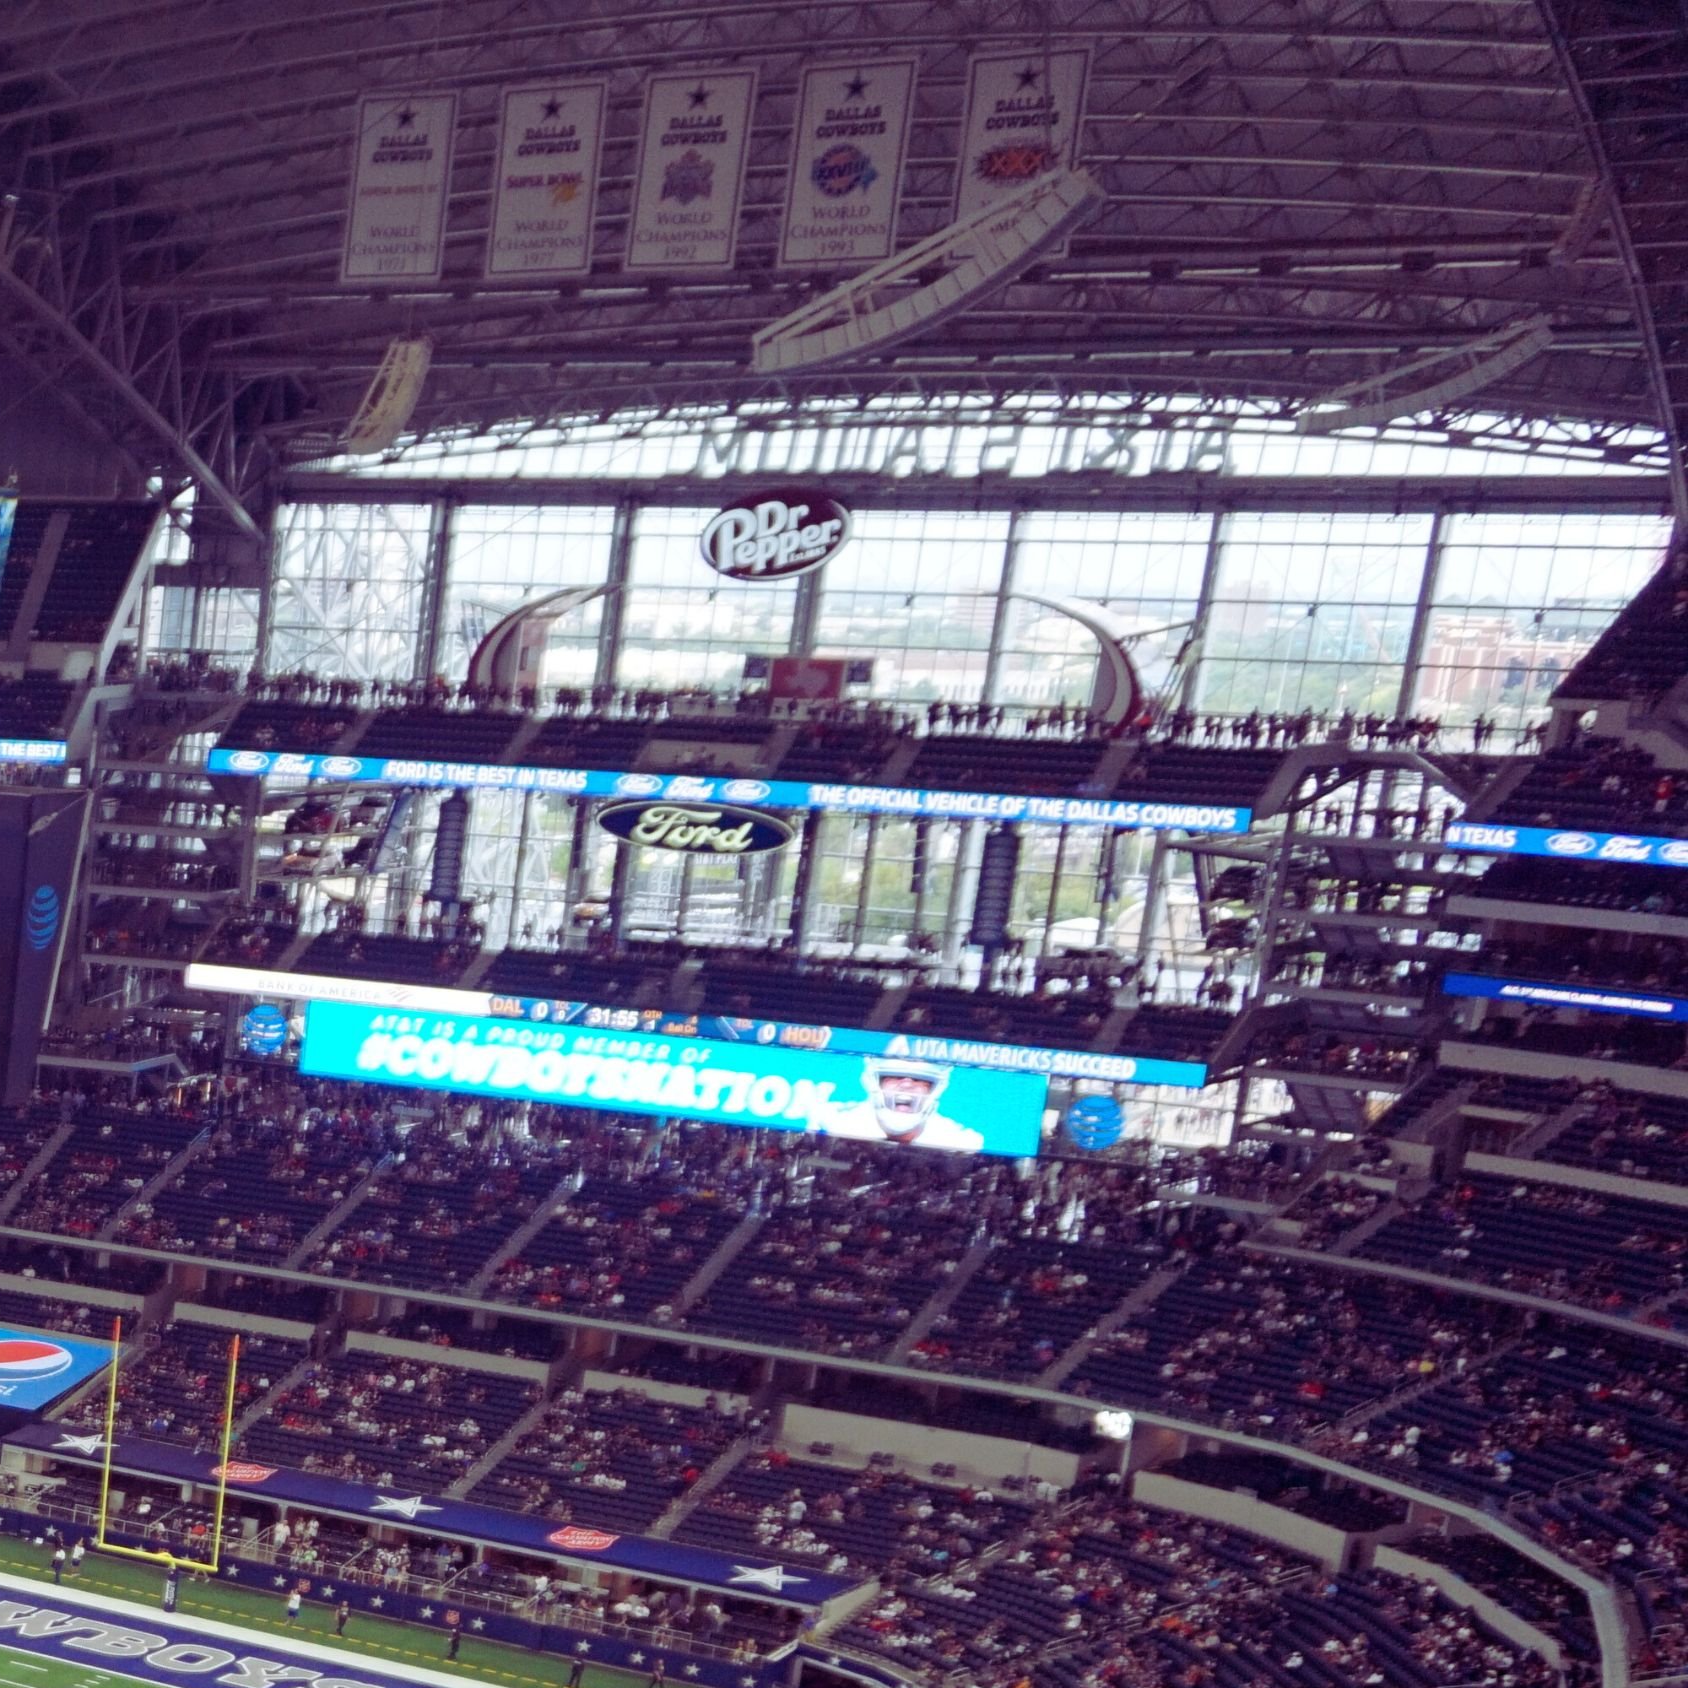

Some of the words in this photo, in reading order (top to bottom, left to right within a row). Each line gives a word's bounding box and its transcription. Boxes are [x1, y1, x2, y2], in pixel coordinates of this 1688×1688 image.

[669, 115, 723, 130] DALLAS
[825, 105, 882, 121] DALLAS
[525, 125, 577, 140] DALLAS
[661, 130, 728, 146] COWBOYS
[816, 121, 887, 139] COWBOYS
[379, 134, 429, 149] DALLAS
[517, 140, 582, 157] COWBOYS
[372, 148, 433, 163] COWBOYS
[657, 212, 712, 225] WORLD
[813, 205, 871, 219] WORLD
[515, 219, 569, 233] WORLD
[791, 224, 886, 239] CHAMPIONS
[755, 500, 809, 540] Dr
[0, 742, 25, 756] THE
[26, 742, 59, 757] BEST
[270, 752, 314, 773] Ford
[386, 760, 425, 778] FORD
[426, 762, 444, 779] IS
[446, 764, 471, 782] THE
[470, 766, 518, 783] BEST
[518, 768, 535, 785] IN
[535, 770, 588, 789] TEXAS
[664, 775, 715, 798] Ford
[809, 785, 846, 803] THE
[846, 788, 924, 809] OFFICIAL
[924, 791, 999, 812] VEHICLE
[999, 795, 1025, 814] OF
[1027, 797, 1064, 817] THE
[1065, 801, 1138, 821] DALLAS
[1143, 805, 1237, 828] COWBOYS
[629, 806, 754, 853] Ford
[1462, 824, 1517, 848] TEXAS
[1598, 835, 1653, 861] Ford
[258, 980, 295, 993] BANK
[319, 986, 383, 1000] AMERICA
[492, 998, 524, 1016] DAL
[588, 1006, 639, 1030] 31:55
[784, 1025, 828, 1047] HOU
[370, 1013, 425, 1033] AT&T
[432, 1017, 456, 1036] IS
[463, 1022, 478, 1041] A
[486, 1026, 566, 1049] PROUD
[572, 1035, 671, 1062] MEMBER
[680, 1046, 713, 1064] OF
[916, 1038, 948, 1058] UTA
[951, 1042, 1051, 1070] MAVERICKS
[1051, 1051, 1138, 1081] SUCCEED
[356, 1032, 837, 1121] #COWBOYSNATION
